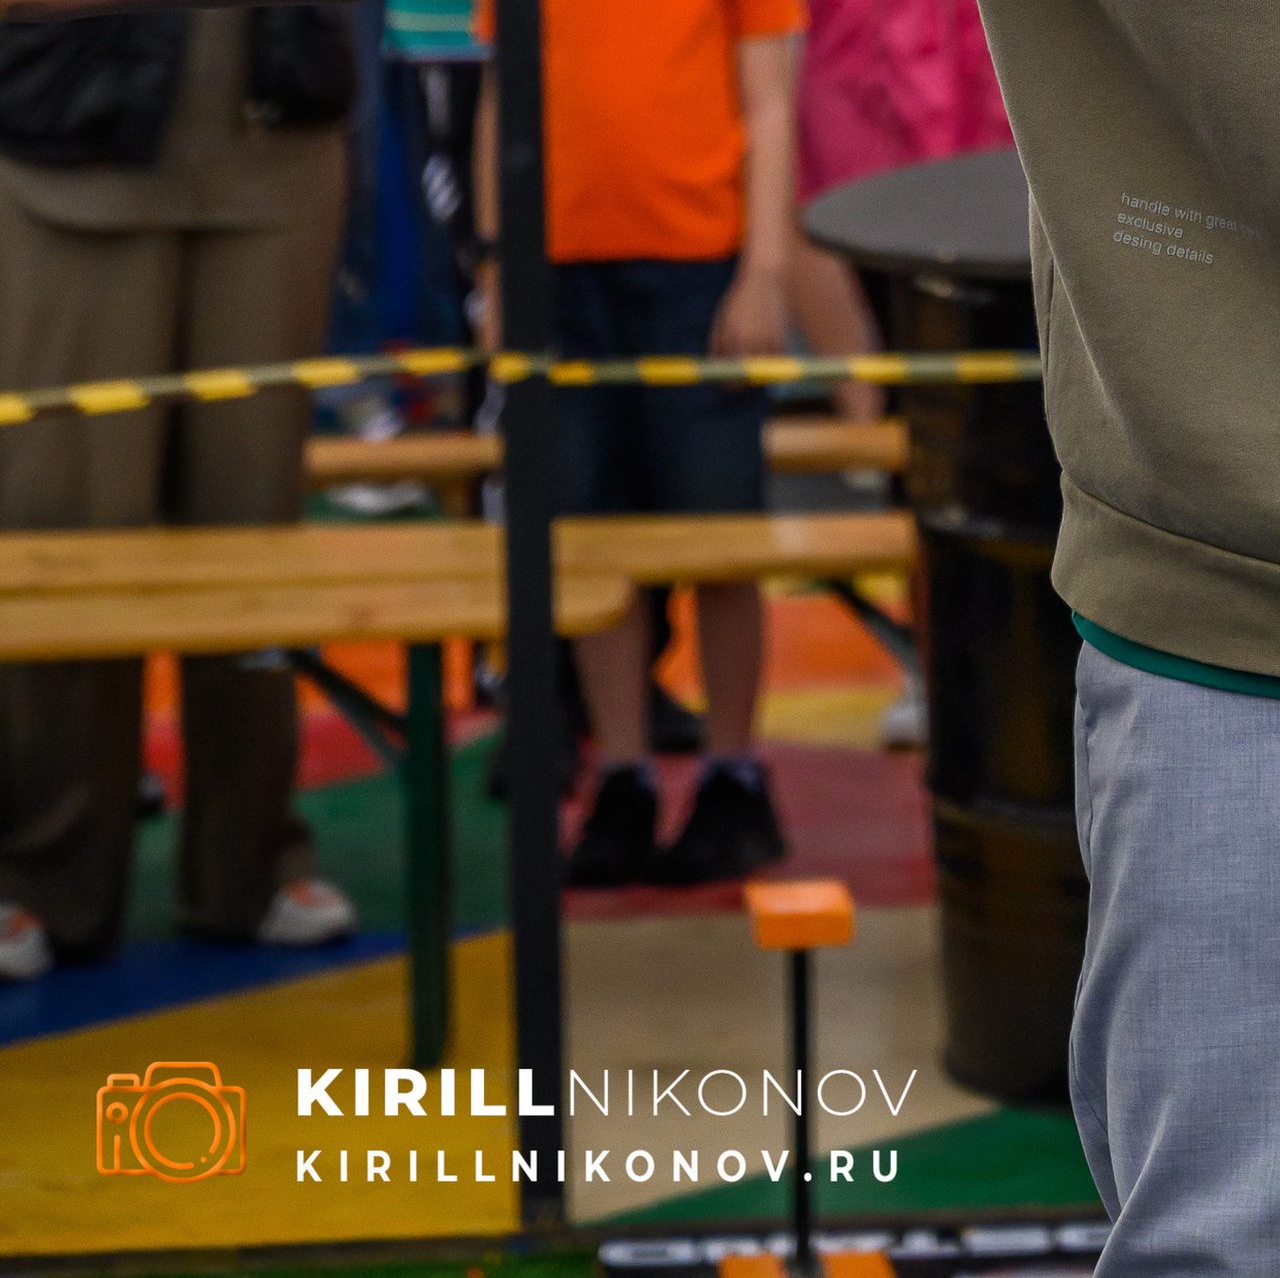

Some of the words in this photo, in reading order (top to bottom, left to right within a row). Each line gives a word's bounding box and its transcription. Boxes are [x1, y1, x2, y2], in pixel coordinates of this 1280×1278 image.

[1116, 211, 1184, 239] exclusive
[1121, 192, 1171, 216] handle
[1174, 207, 1202, 224] with
[1206, 214, 1238, 231] great
[1112, 229, 1163, 256] desing
[1166, 243, 1214, 265] details
